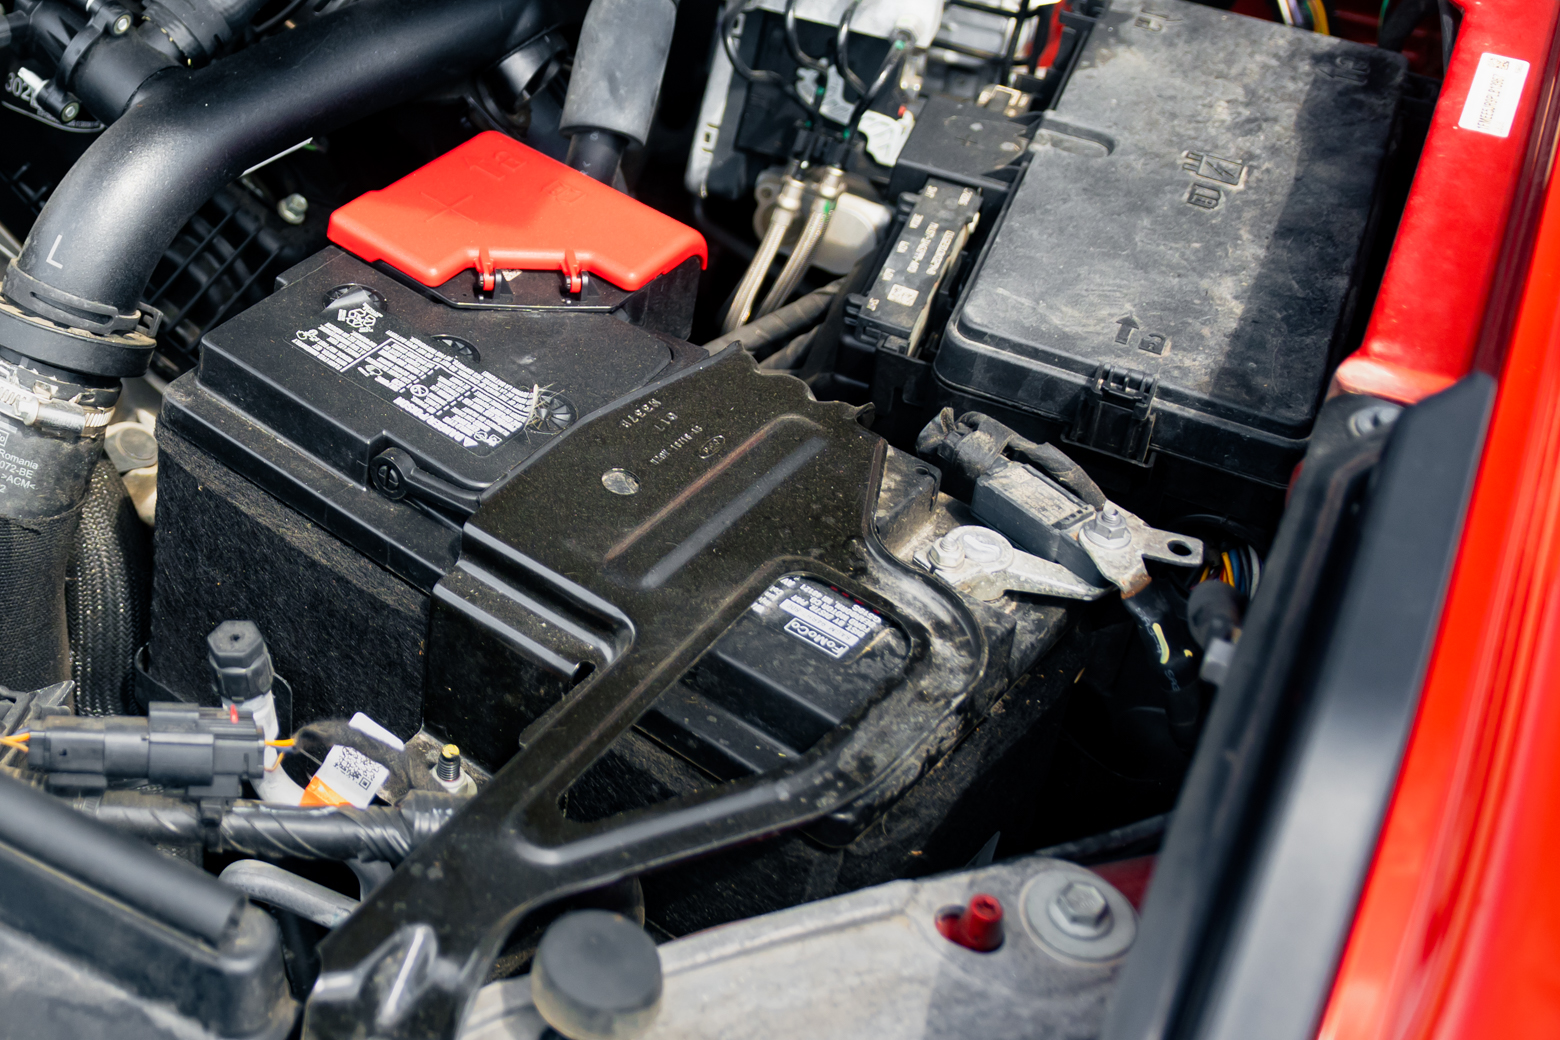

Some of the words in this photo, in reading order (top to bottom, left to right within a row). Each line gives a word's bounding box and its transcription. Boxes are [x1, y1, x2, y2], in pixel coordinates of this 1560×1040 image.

[46, 234, 63, 269] L
[820, 602, 850, 620] MOTOR
[791, 621, 844, 654] FoMoCo
[848, 618, 871, 634] FORD
